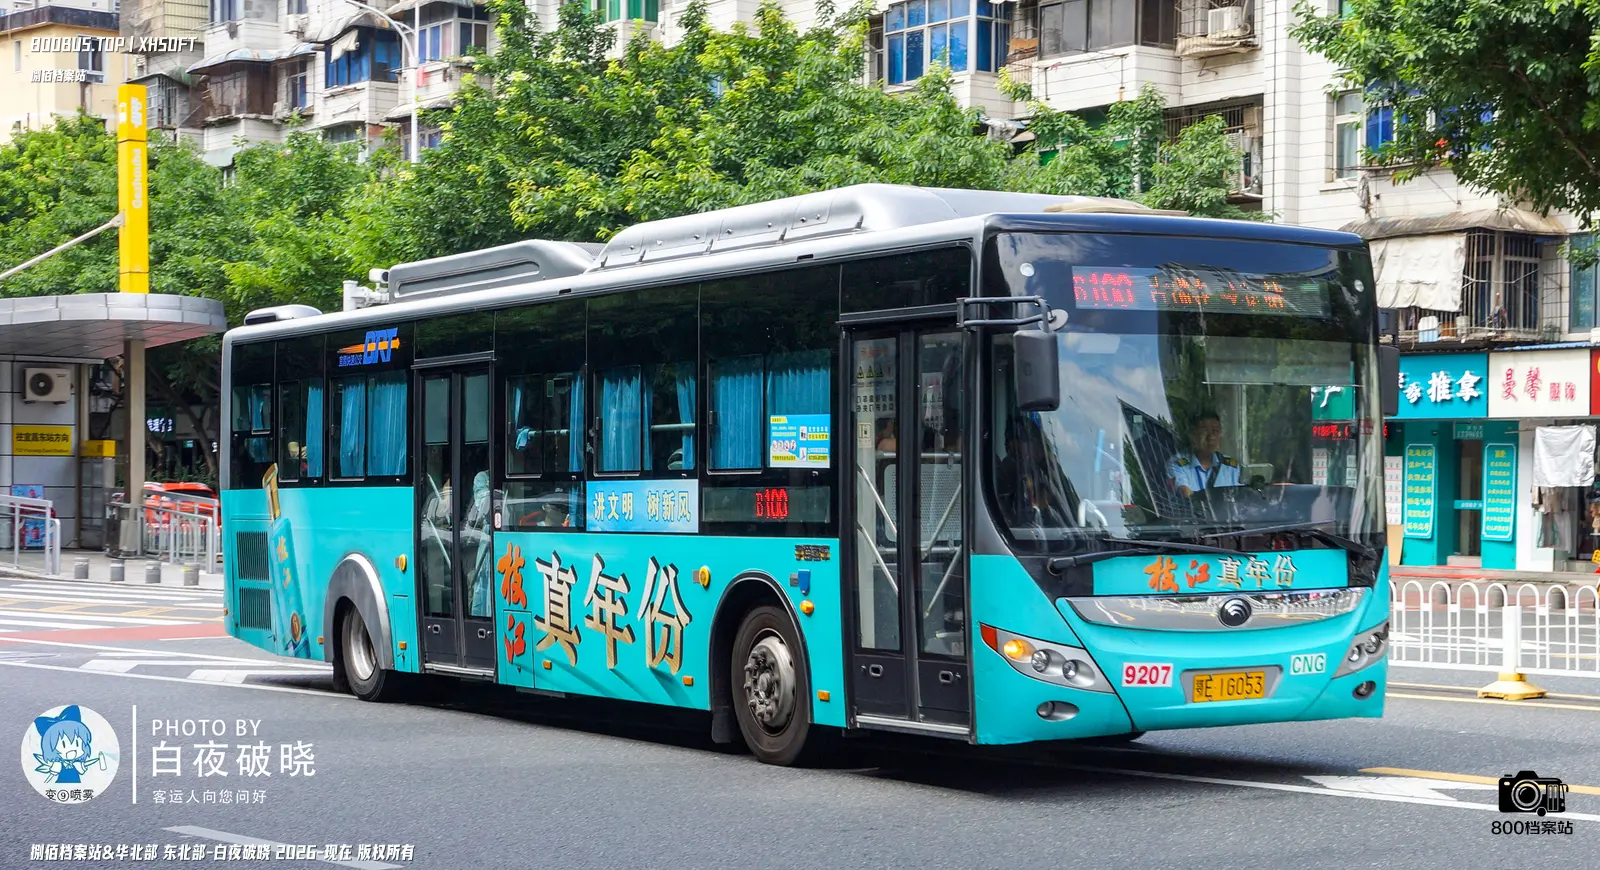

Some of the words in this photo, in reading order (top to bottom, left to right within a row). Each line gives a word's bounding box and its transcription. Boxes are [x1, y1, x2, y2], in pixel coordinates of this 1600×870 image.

[363, 327, 398, 364] BRT
[592, 491, 634, 521] 讲文明
[647, 490, 691, 522] 树新风
[755, 488, 788, 519] B100
[497, 541, 528, 665] 枝江
[534, 550, 693, 676] 真年份
[1124, 664, 1171, 686] 9207
[1292, 655, 1325, 673] CNG
